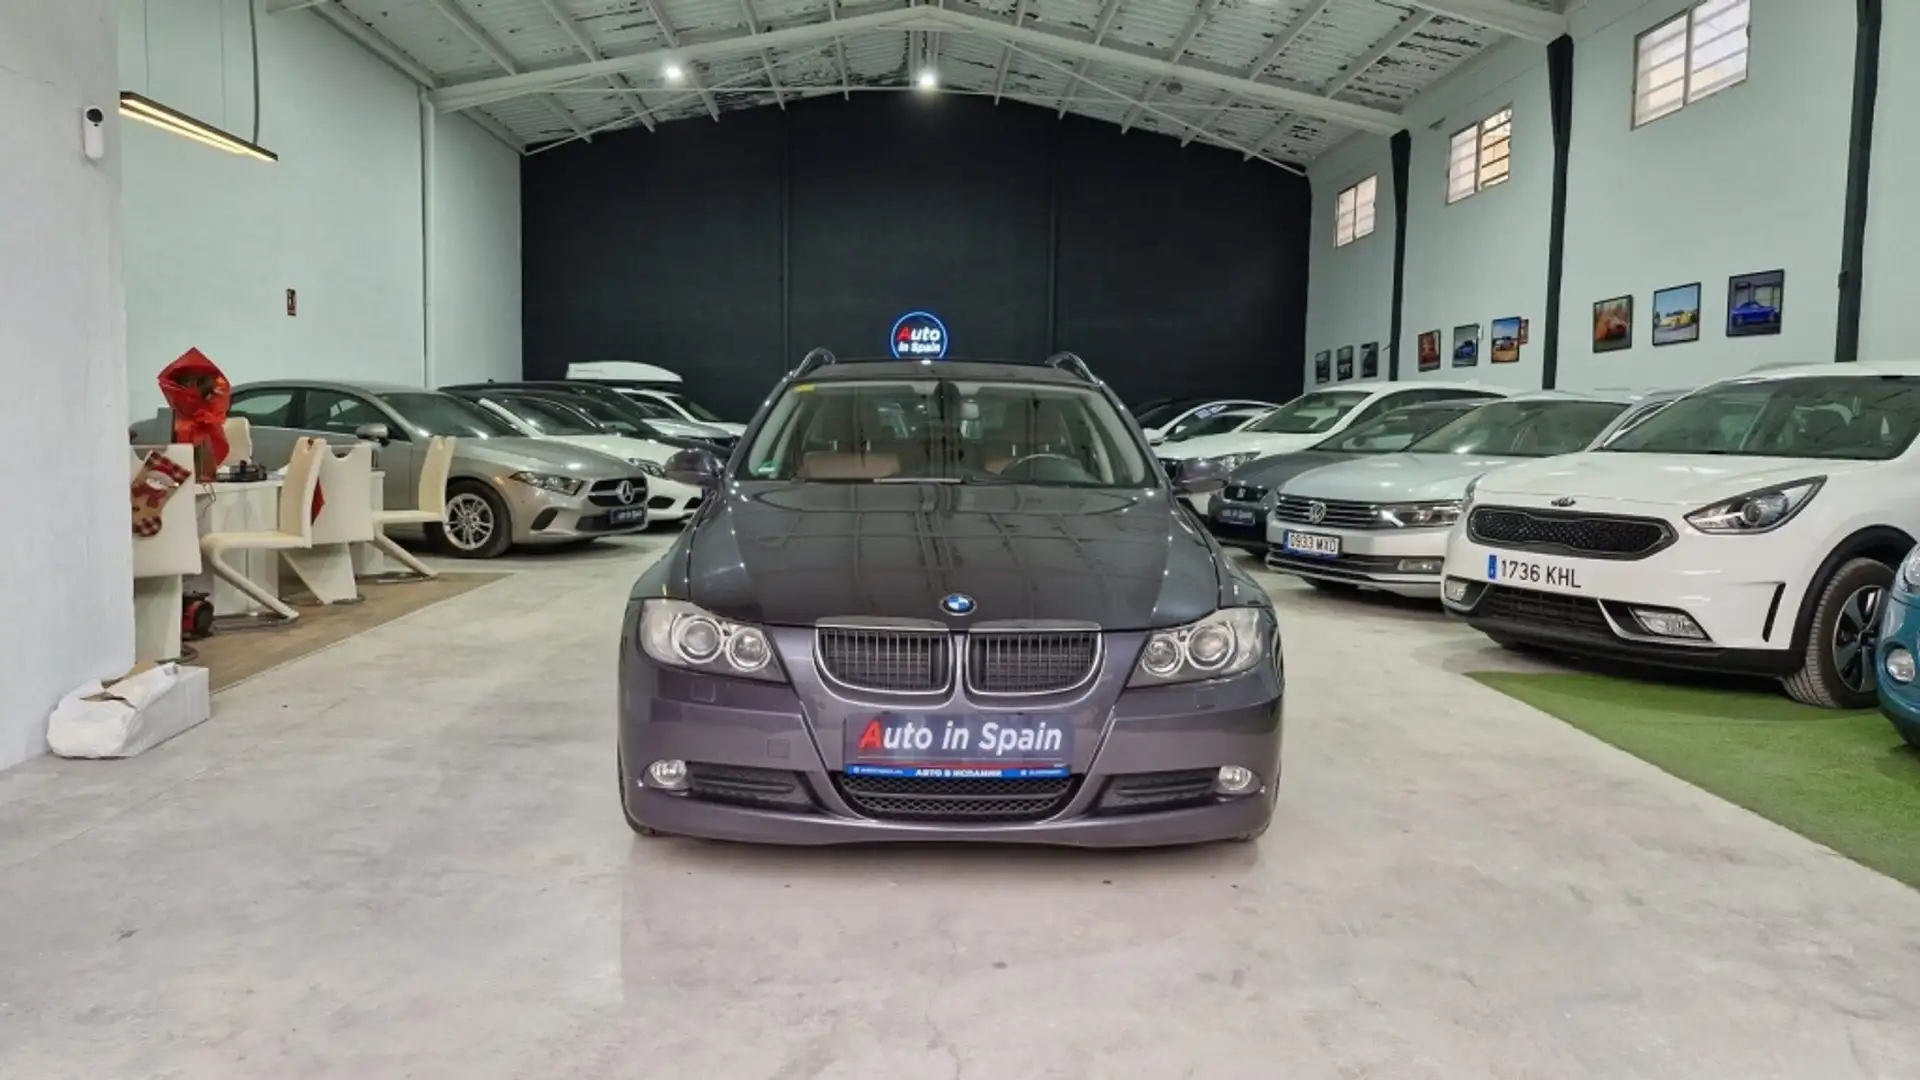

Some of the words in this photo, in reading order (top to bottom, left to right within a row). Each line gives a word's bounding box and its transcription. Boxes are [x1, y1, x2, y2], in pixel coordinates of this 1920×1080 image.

[897, 326, 941, 341] Auto
[1501, 560, 1541, 582] 1736
[1546, 565, 1582, 588] KHL
[859, 719, 933, 749] Auto
[941, 720, 970, 750] in
[978, 721, 1063, 756] Spain
